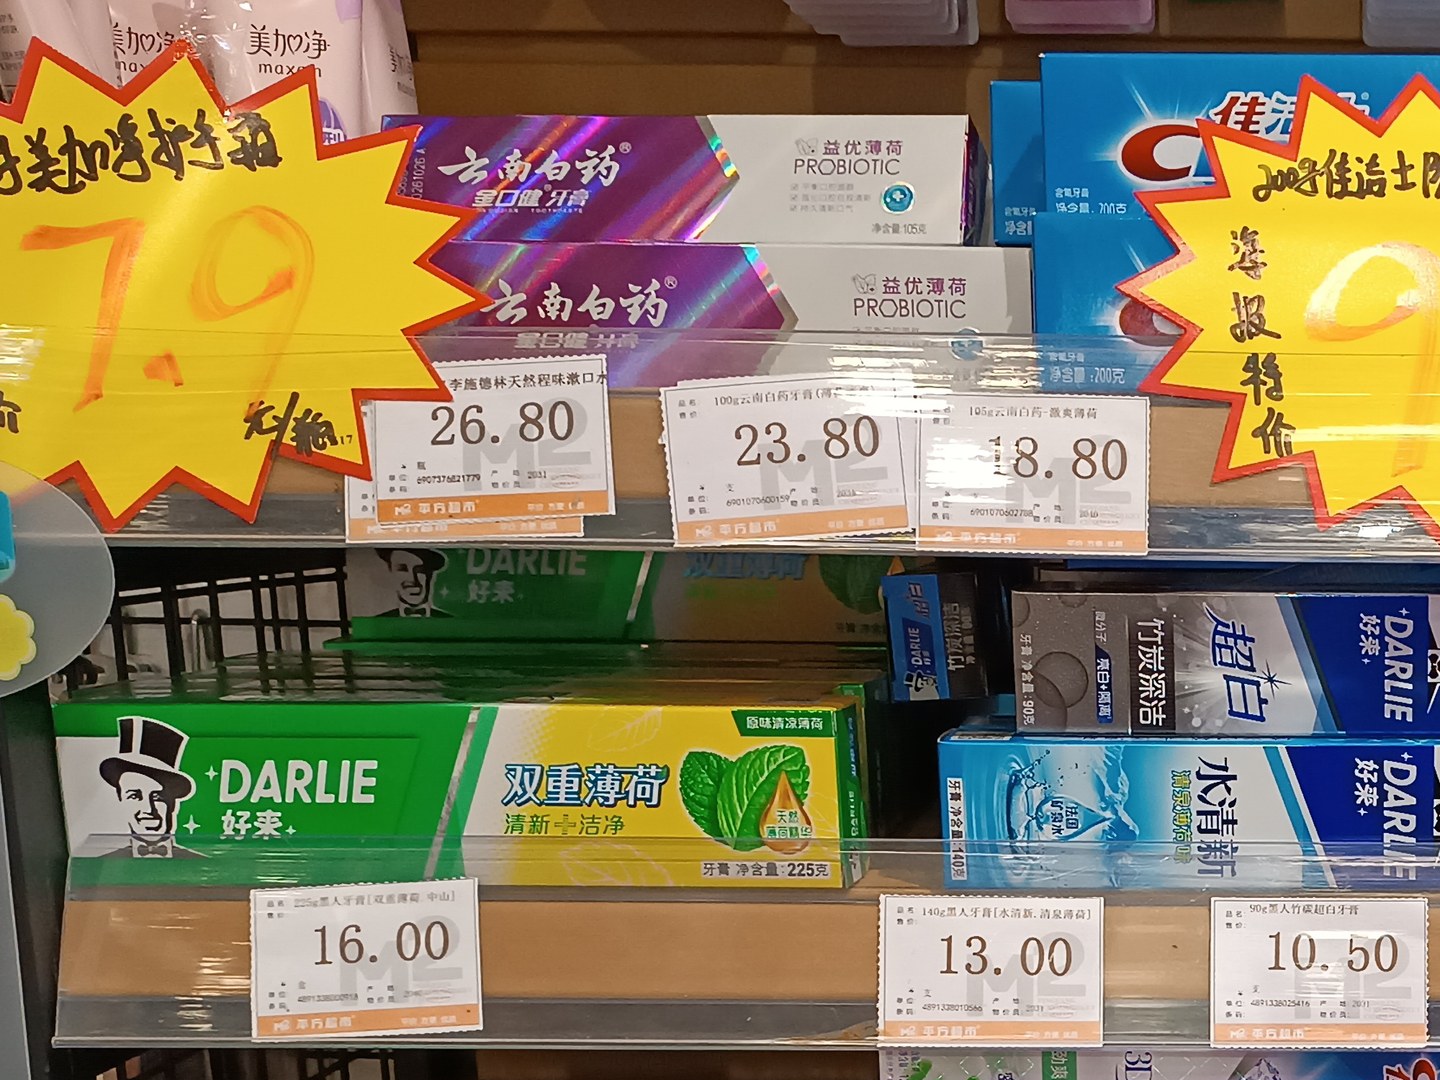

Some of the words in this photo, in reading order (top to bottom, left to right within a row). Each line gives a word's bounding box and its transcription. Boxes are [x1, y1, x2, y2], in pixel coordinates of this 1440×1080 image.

[437, 145, 620, 187] 云南白药
[793, 158, 901, 176] PROBIOTIC
[822, 140, 903, 156] 益优薄荷
[480, 279, 668, 328] 云南白药
[853, 298, 967, 319] PROBIOTIC
[882, 278, 967, 296] 益优薄荷
[430, 400, 575, 446] 26.80
[734, 414, 880, 467] 23.80
[988, 435, 1128, 482] 18.80
[1359, 612, 1382, 658] 好来
[1136, 618, 1168, 729] 竹炭深洁
[1203, 602, 1268, 724] 超白
[1383, 614, 1414, 724] DARLIE
[745, 715, 824, 731] 原味清凉薄荷
[219, 759, 379, 804] DARLIE
[501, 762, 670, 808] 双重薄荷
[1353, 757, 1379, 809] 好来
[219, 808, 285, 841] 好来
[1196, 754, 1240, 879] 水清新
[1382, 757, 1419, 881] DARLIE
[313, 920, 450, 966] 16.00
[939, 934, 1073, 977] 13.00
[1267, 931, 1399, 973] 10.50
